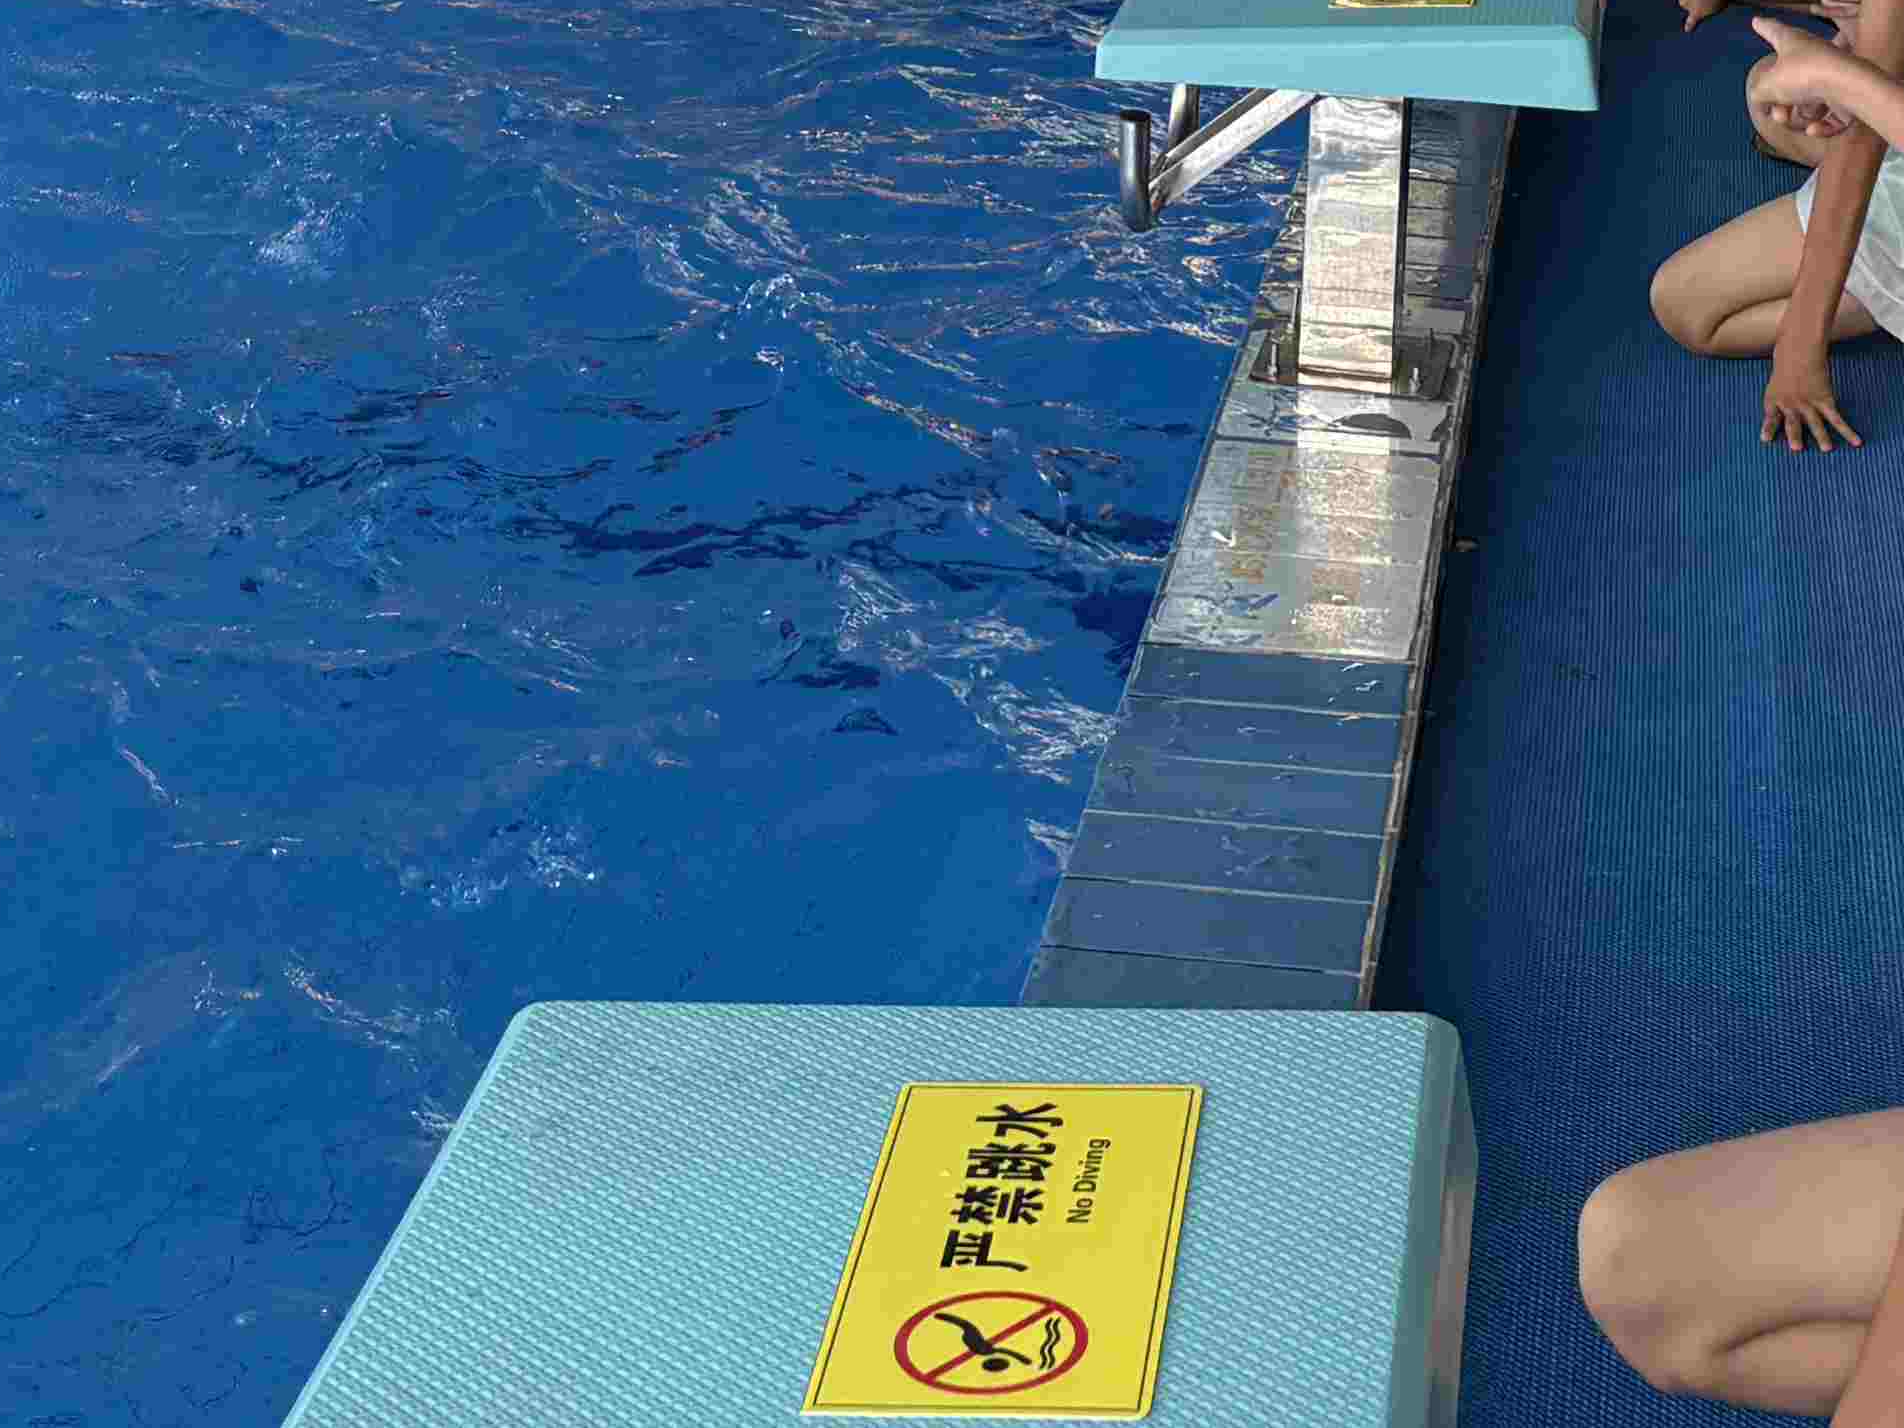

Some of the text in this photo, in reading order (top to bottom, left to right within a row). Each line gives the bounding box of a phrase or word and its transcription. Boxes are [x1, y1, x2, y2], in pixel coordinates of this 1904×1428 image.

[939, 1102, 1063, 1271] 严禁跳水
[1065, 1137, 1111, 1225] No Diving
